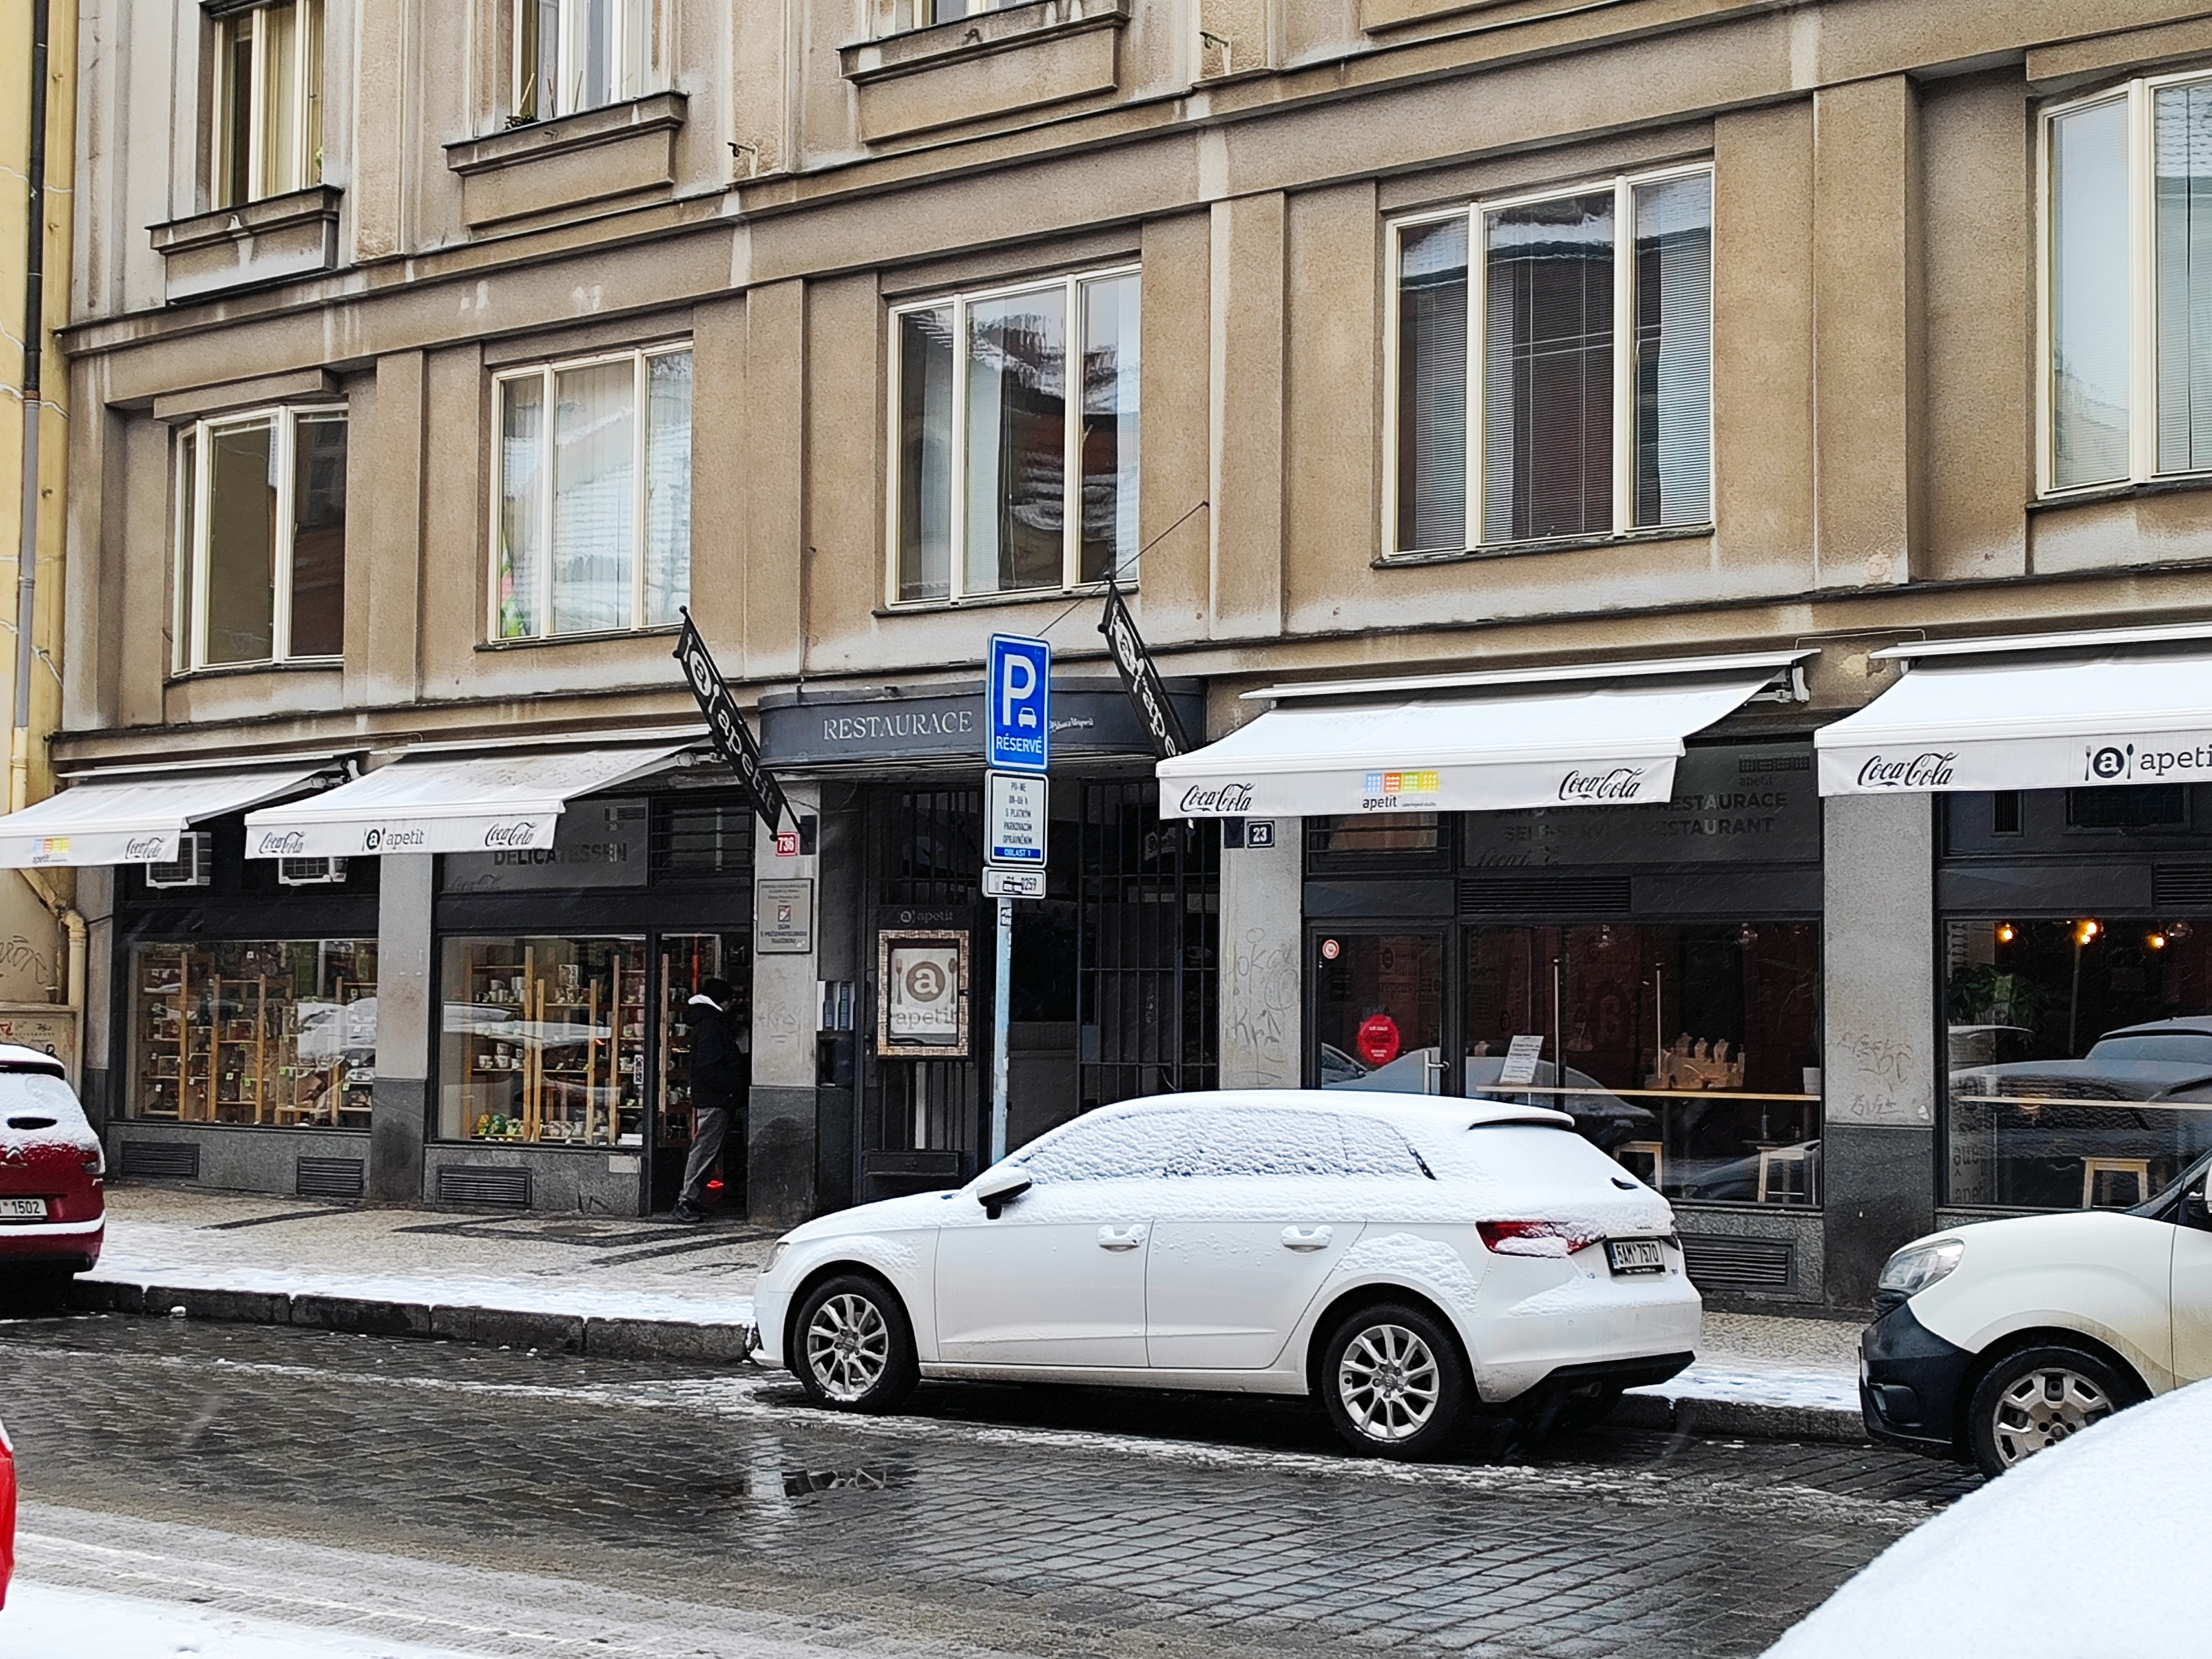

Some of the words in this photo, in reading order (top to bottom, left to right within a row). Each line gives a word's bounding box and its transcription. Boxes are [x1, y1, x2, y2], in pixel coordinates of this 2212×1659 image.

[1003, 654, 1036, 726] P
[823, 711, 973, 740] RESTAURACE
[996, 733, 1042, 754] RÉSERVÉ
[1858, 753, 1959, 787] Coca-Cola
[1558, 768, 1647, 801] Coca-Cola
[1180, 783, 1256, 812] Coca-Cola
[1363, 795, 1398, 810] apetit
[387, 829, 424, 846] apetit
[778, 836, 794, 851] 736
[1253, 827, 1267, 842] 23
[1004, 848, 1026, 857] OBLAST
[917, 910, 953, 923] apetit
[896, 1008, 957, 1030] apetit
[11, 1201, 41, 1214] 1502
[1637, 1243, 1659, 1264] 7570
